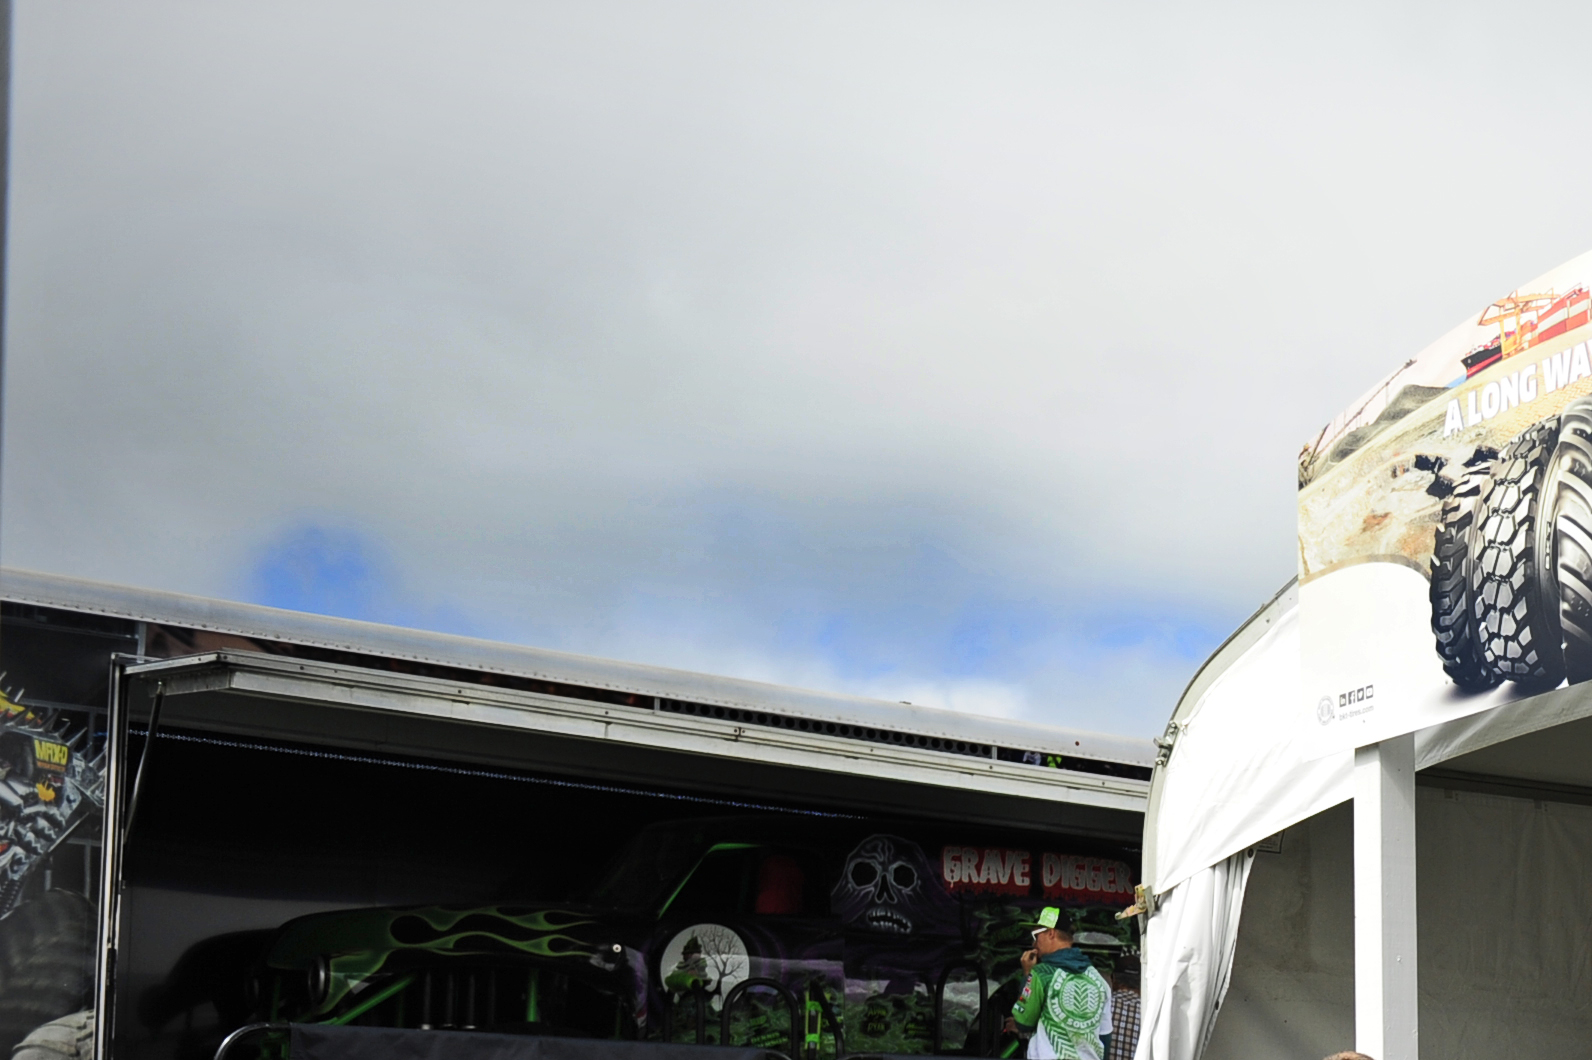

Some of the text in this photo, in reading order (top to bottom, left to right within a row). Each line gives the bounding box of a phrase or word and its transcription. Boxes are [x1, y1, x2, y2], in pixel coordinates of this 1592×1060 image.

[1442, 397, 1465, 438] A
[1467, 362, 1539, 428] LONG
[943, 846, 1135, 895] GRAVE DIGGER
